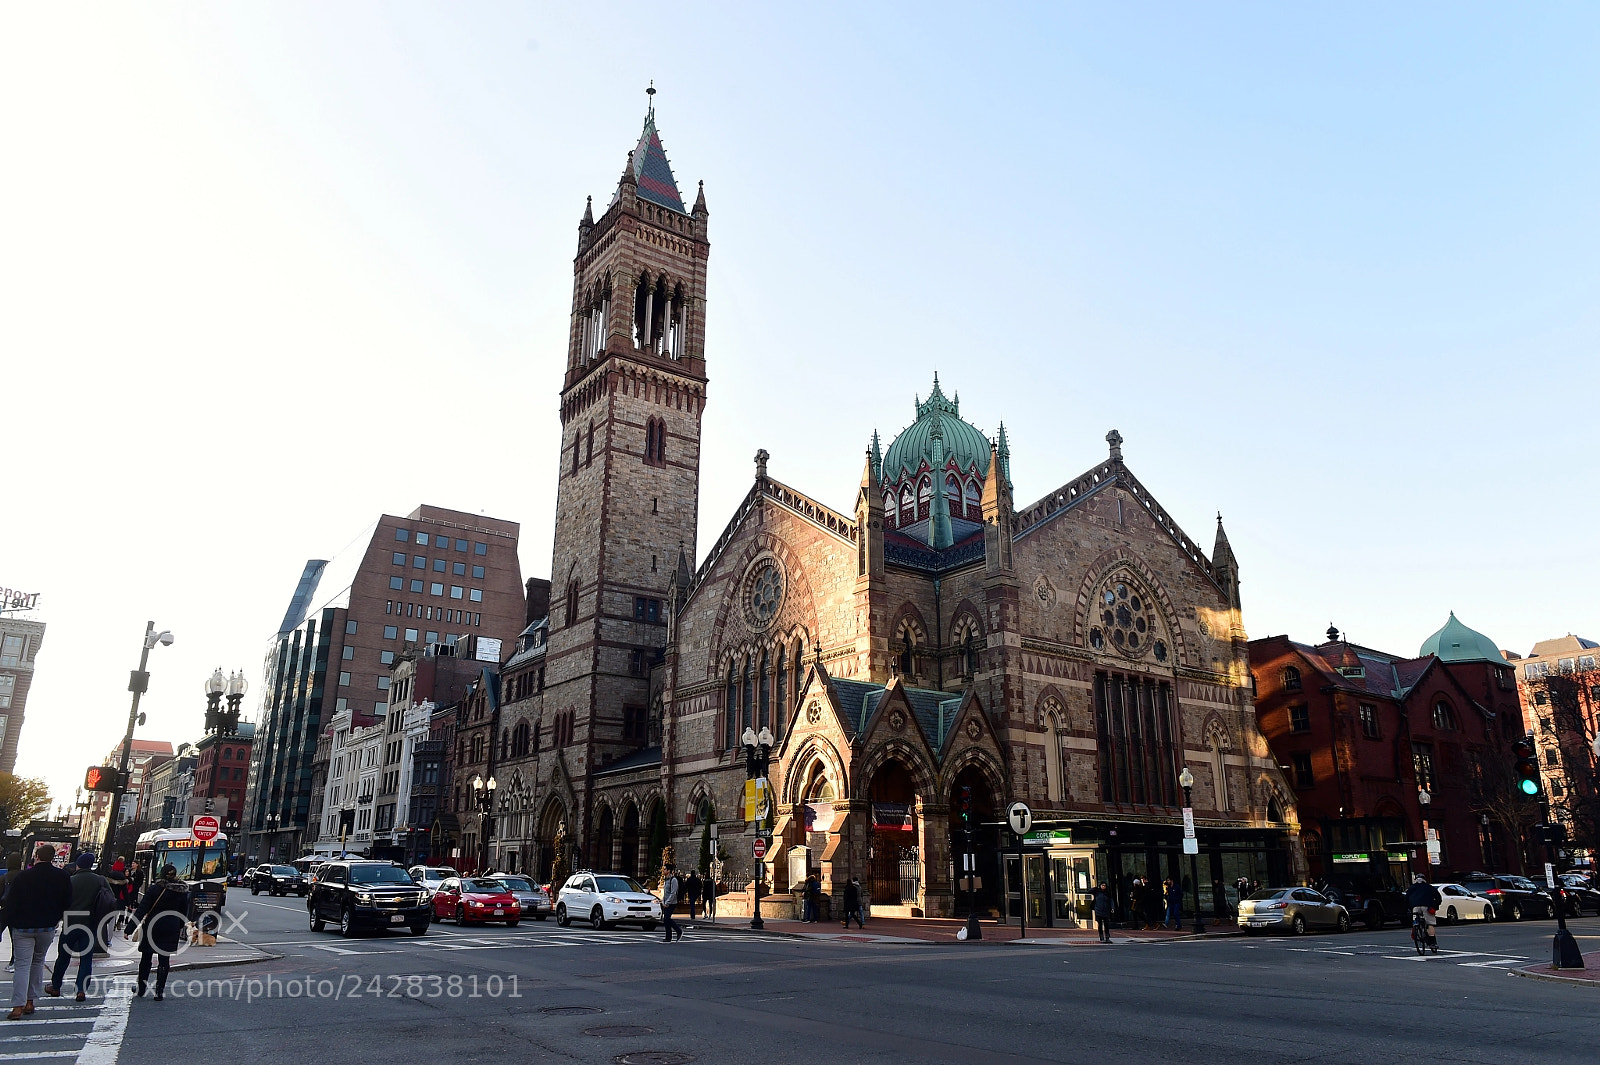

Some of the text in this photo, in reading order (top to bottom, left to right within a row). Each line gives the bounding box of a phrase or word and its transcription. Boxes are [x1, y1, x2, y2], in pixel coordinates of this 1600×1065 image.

[1012, 809, 1028, 828] T
[1036, 831, 1056, 839] COPLEY
[167, 840, 174, 849] 9
[175, 840, 192, 848] CITY
